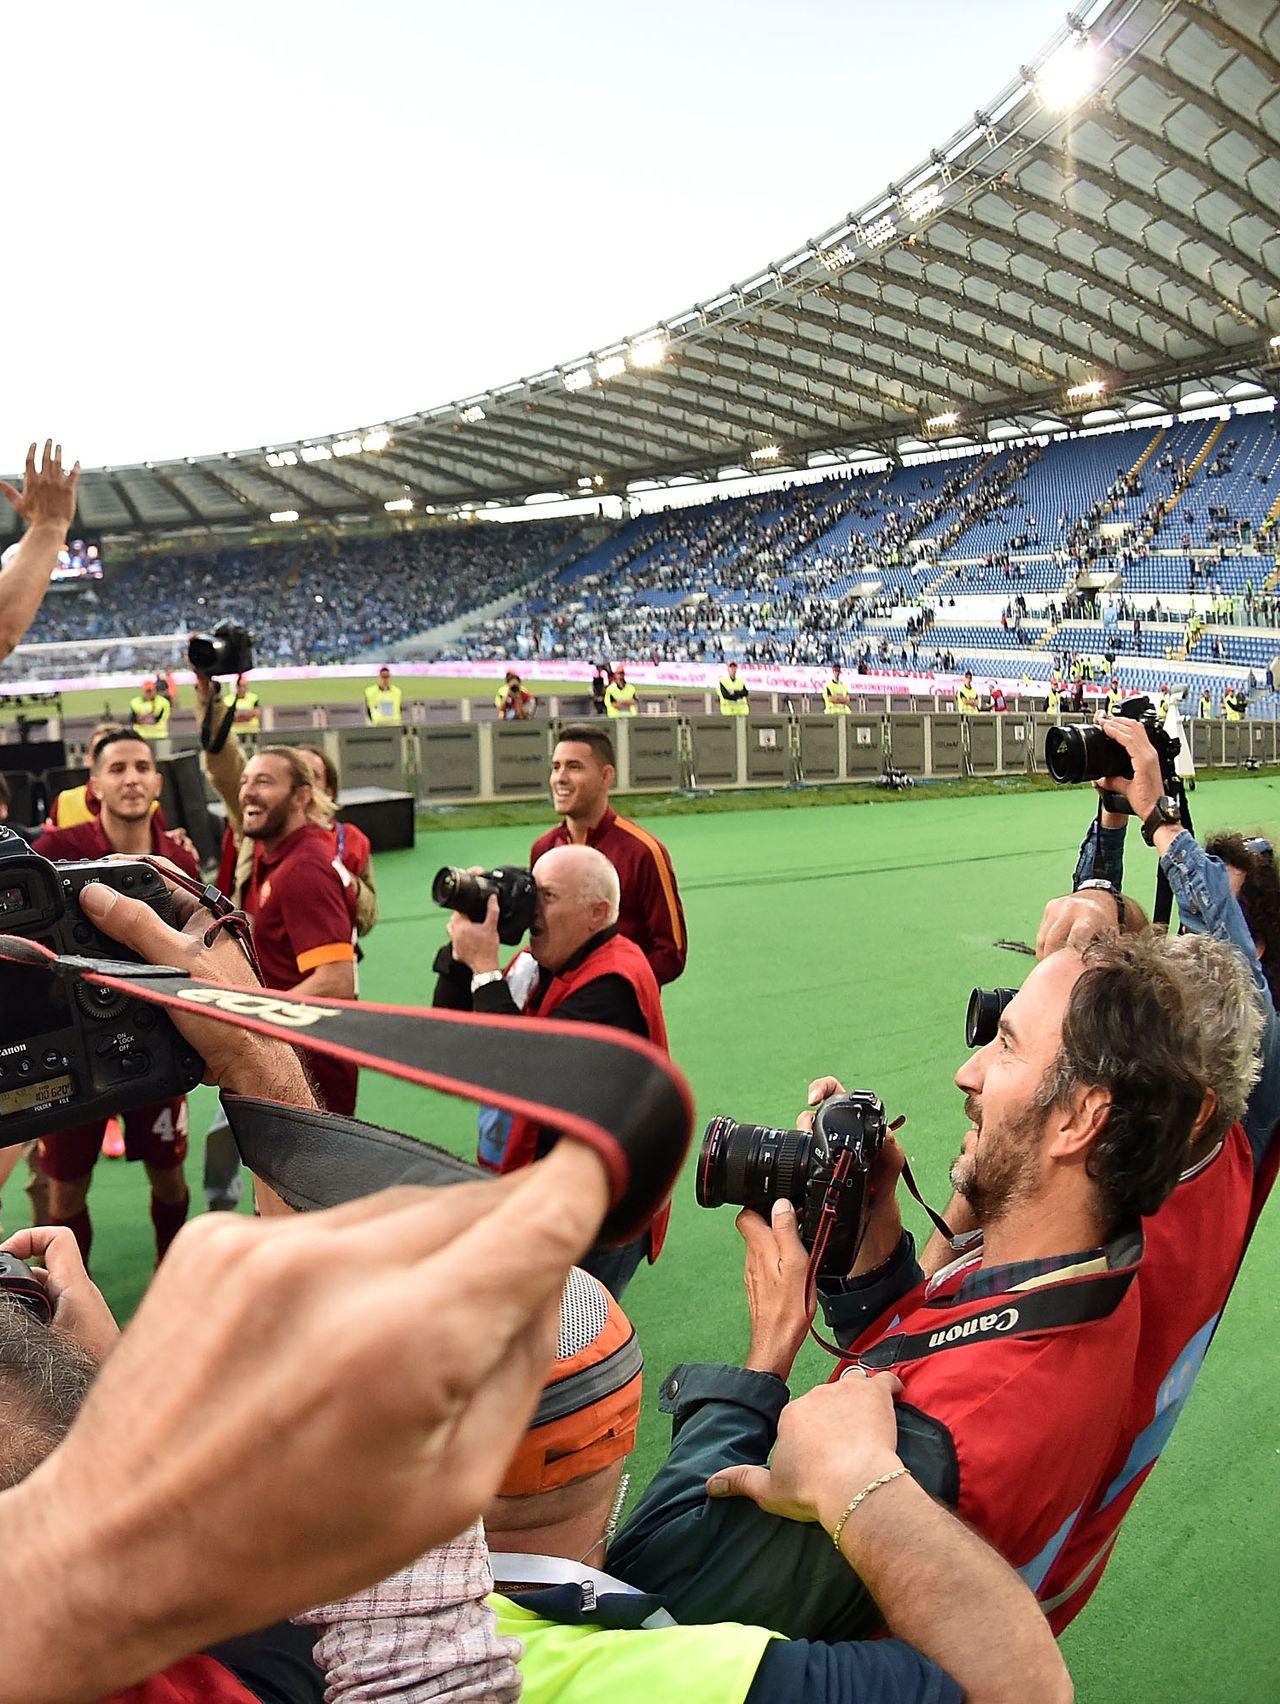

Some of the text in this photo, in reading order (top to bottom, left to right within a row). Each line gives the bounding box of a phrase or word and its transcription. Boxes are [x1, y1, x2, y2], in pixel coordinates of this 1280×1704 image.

[100, 987, 110, 995] SET
[117, 1032, 127, 1040] ON
[118, 1036, 135, 1044] LOCK
[59, 1097, 70, 1105] FILE
[34, 1102, 52, 1112] FOLDER
[928, 1308, 1019, 1348] Canon
